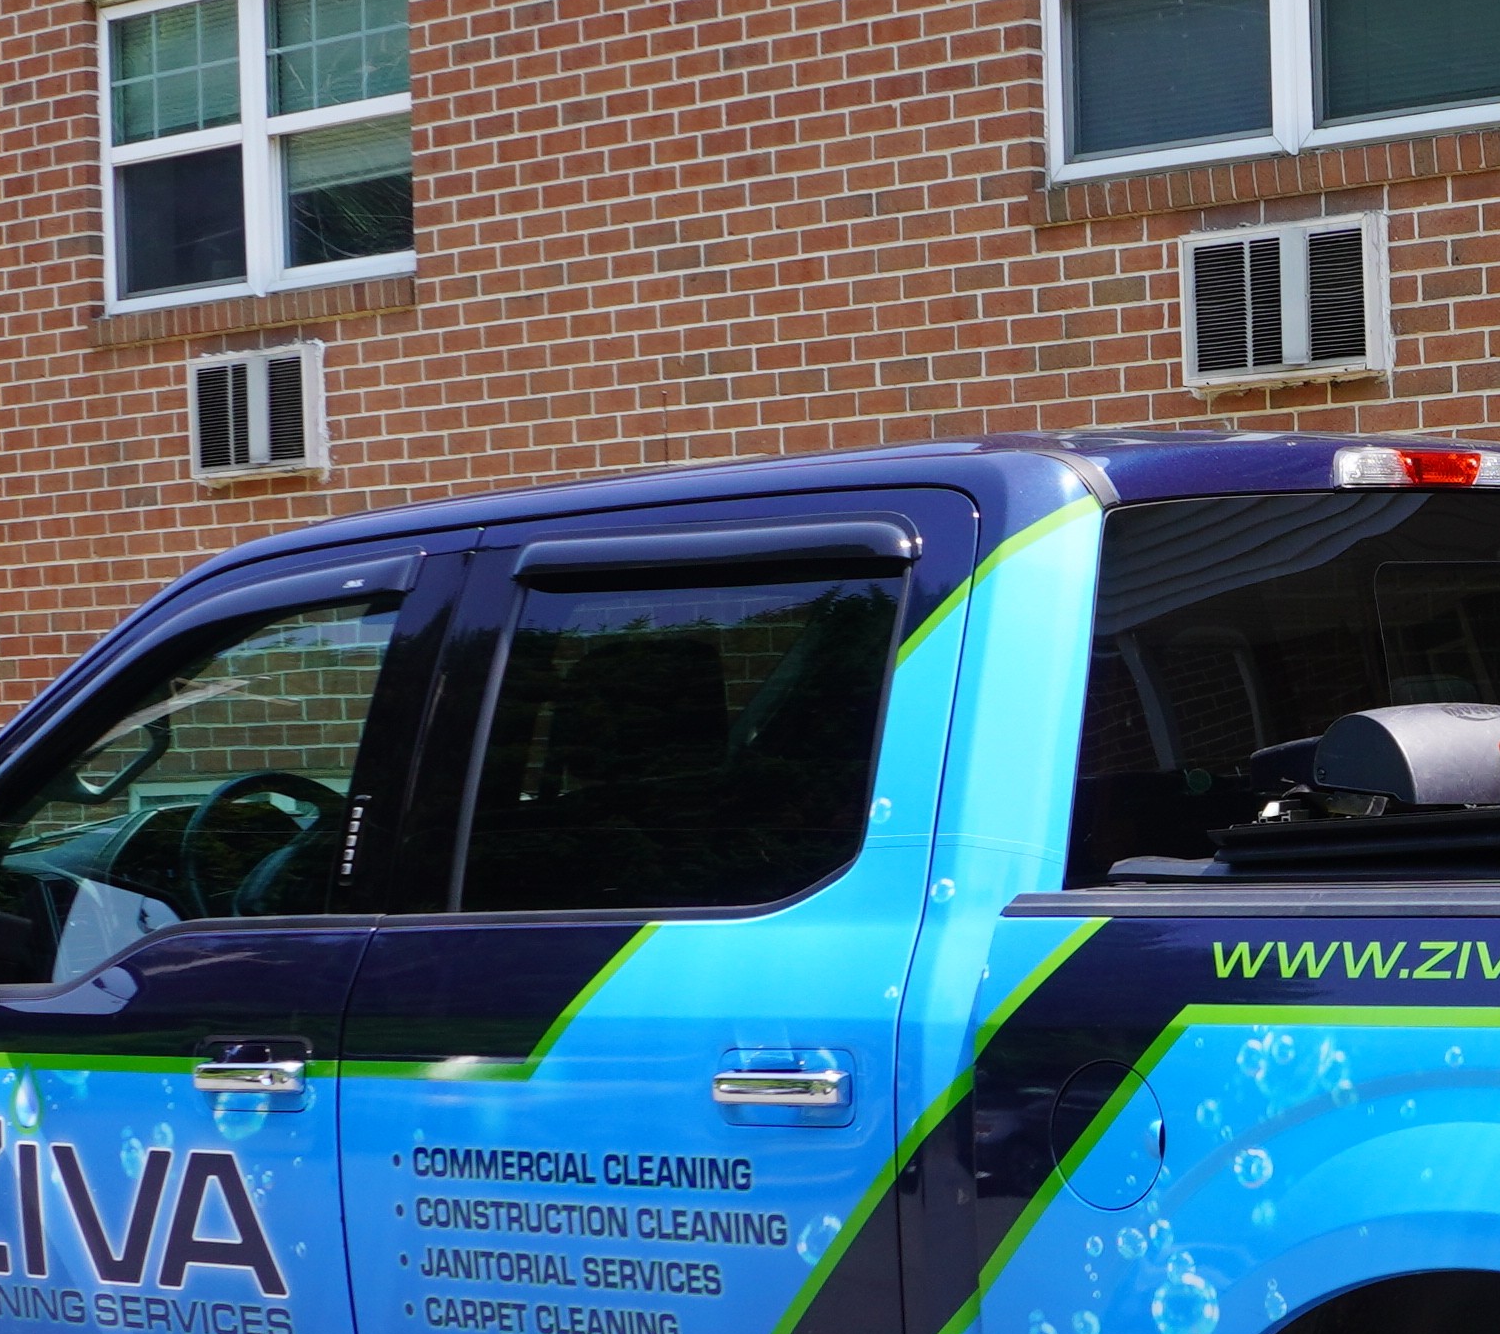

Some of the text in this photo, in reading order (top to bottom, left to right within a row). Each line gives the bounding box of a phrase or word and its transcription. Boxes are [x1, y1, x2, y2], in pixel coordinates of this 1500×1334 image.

[412, 1146, 752, 1191] COMMERCIAL CLEANING
[415, 1197, 788, 1246] CONSTRUCTION CLEANING
[420, 1247, 723, 1296] JANITORIAL SERVICES
[424, 1296, 528, 1332] CARPET
